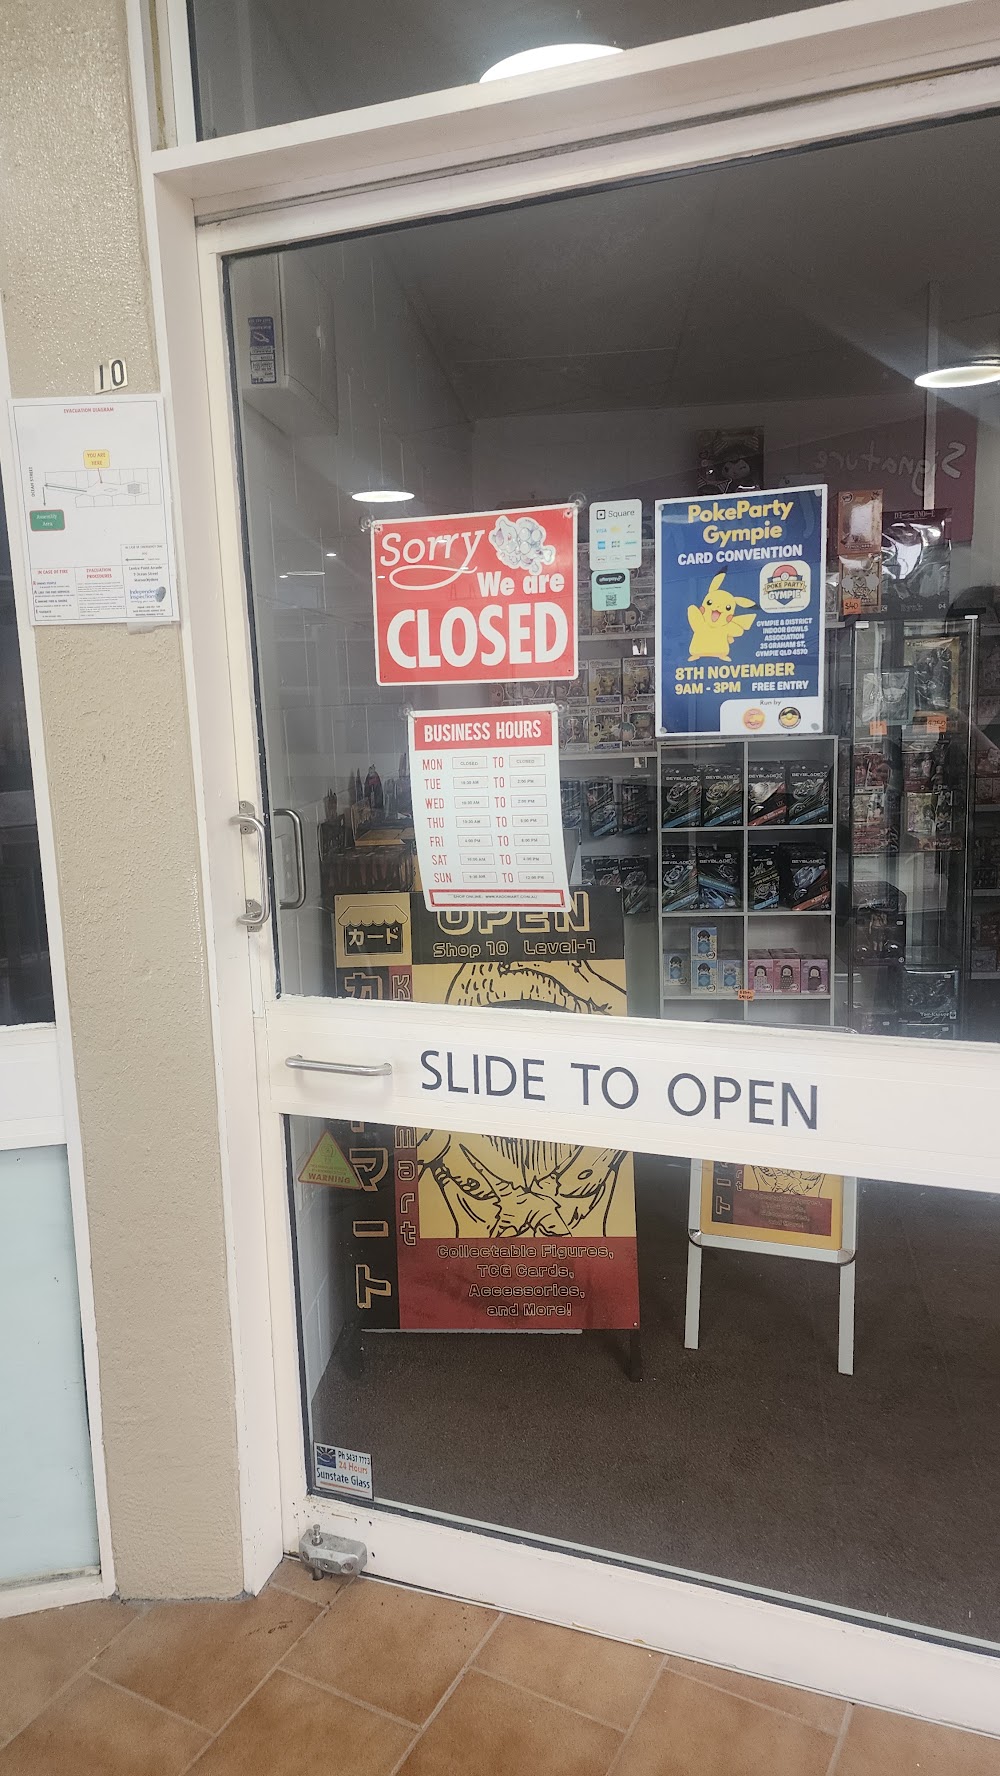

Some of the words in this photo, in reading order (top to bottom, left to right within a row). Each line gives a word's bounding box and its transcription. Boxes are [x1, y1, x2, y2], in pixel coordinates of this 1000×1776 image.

[99, 360, 124, 390] 10
[608, 510, 635, 518] Square
[687, 499, 794, 524] PokeParty
[703, 521, 783, 548] Gympie
[380, 529, 485, 590] Sorry
[678, 552, 713, 566] CARD
[716, 544, 803, 562] CONVENTION
[477, 571, 515, 597] We
[522, 573, 565, 595] are
[768, 590, 801, 600] GYMPIE
[386, 602, 568, 669] CLOSED
[764, 633, 804, 641] ASSOCIATION
[675, 666, 704, 681] 8TH
[708, 662, 795, 679] NOVEMBER
[675, 683, 703, 696] 9AM
[713, 681, 741, 694] 3PM
[752, 682, 775, 692] FREE
[777, 680, 809, 691] ENTRY
[773, 698, 781, 706] by
[424, 722, 490, 743] BUSINESS
[496, 720, 541, 740] HOURS
[422, 759, 443, 770] MON
[493, 757, 504, 768] TO
[425, 779, 441, 790] TUE
[493, 777, 504, 788] TO
[425, 798, 444, 809] WED
[494, 797, 505, 808] TO
[427, 817, 444, 829] THU
[496, 817, 507, 827] TO
[430, 836, 444, 847] FRI
[497, 836, 509, 846] TO
[432, 855, 447, 865] SAT
[500, 855, 511, 865] TO
[434, 873, 452, 883] SUN
[502, 873, 513, 883] TO
[348, 926, 399, 946] カード
[433, 942, 481, 958] Shop
[485, 940, 509, 957] 10
[524, 939, 596, 955] Level-1
[421, 1050, 546, 1101] SLIDE
[571, 1062, 639, 1110] TO
[667, 1072, 818, 1130] OPEN
[309, 1172, 350, 1183] WARNING
[437, 1245, 536, 1258] Collectable
[542, 1245, 614, 1259] Figures,
[477, 1265, 511, 1278] TCG
[515, 1265, 574, 1279] Cards,
[469, 1284, 585, 1299] Accessories,
[486, 1303, 519, 1316] and
[523, 1303, 573, 1316] More!
[338, 1451, 345, 1460] Ph
[339, 1461, 347, 1470] 24
[349, 1463, 368, 1474] Hours
[317, 1468, 349, 1483] Sunstate
[351, 1476, 370, 1489] Glass
